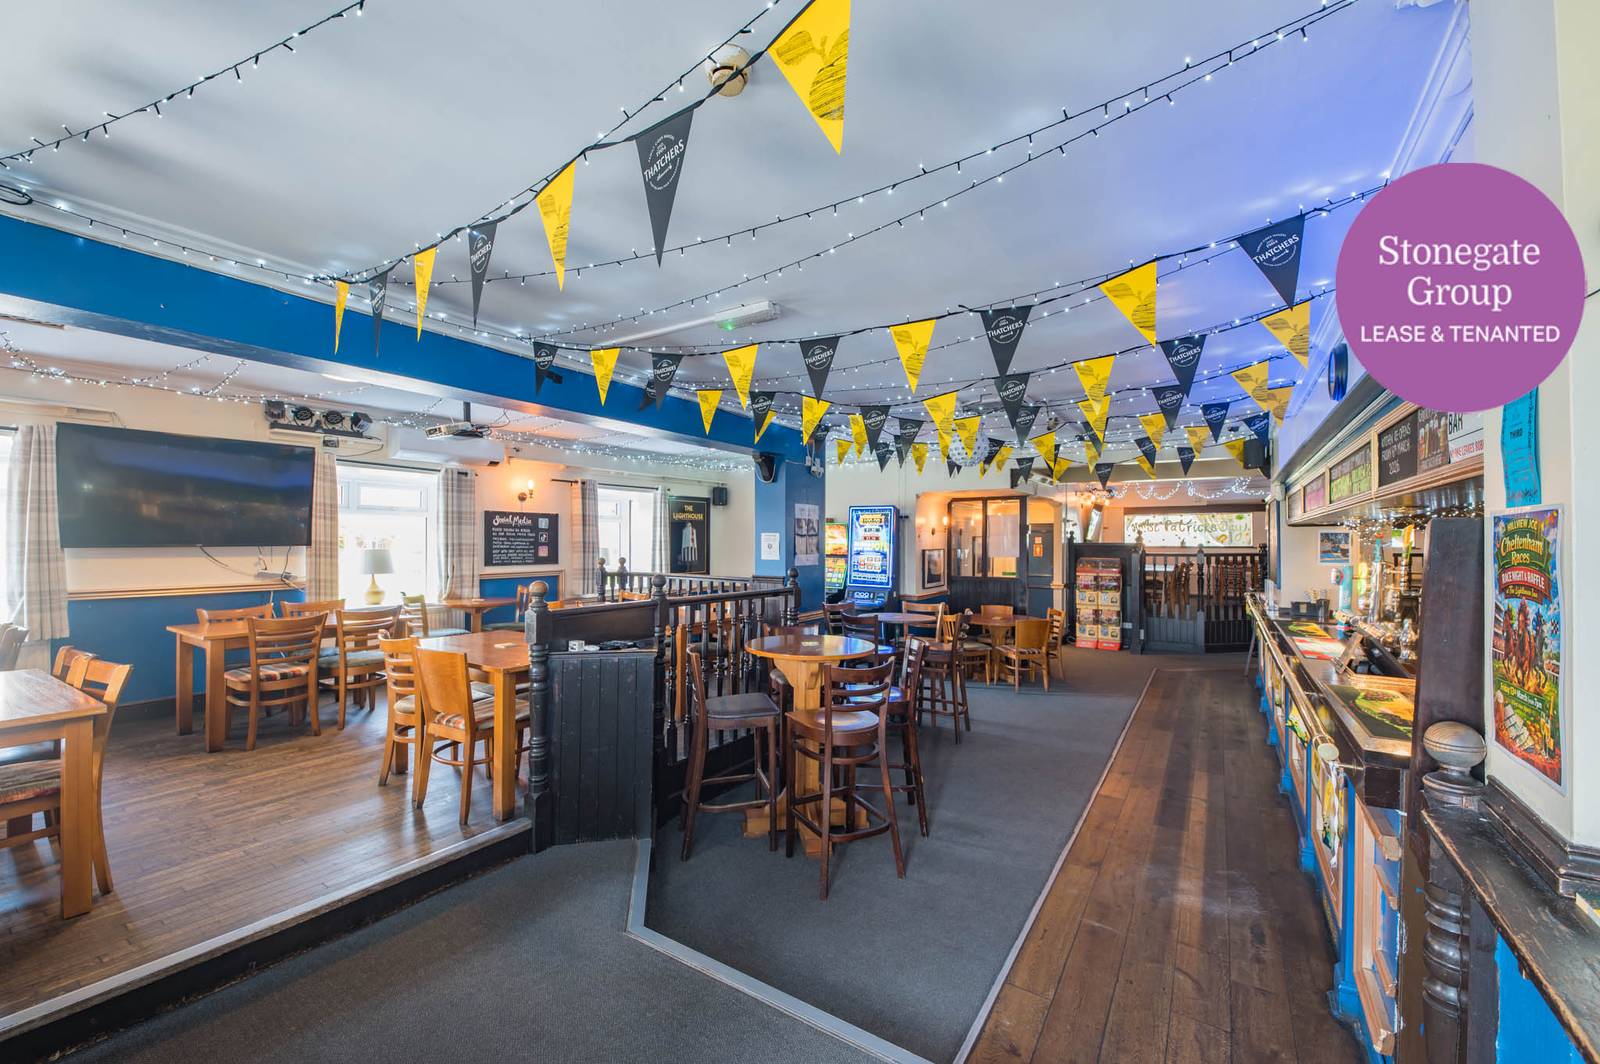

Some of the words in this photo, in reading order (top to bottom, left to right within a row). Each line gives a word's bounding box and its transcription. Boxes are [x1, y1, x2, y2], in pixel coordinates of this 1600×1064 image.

[643, 139, 685, 182] THATCHERS
[470, 240, 492, 264] THATCHERS
[1252, 234, 1300, 264] THATCHERS
[987, 319, 1024, 338] THATCHERS
[804, 348, 834, 364] THATCHERS
[1169, 346, 1201, 363] THATCHERS
[653, 364, 677, 375] THATCHERS
[1000, 383, 1026, 397] THATCHERS
[1158, 393, 1183, 405] THATCHERS
[864, 414, 886, 424] THATCHERS
[684, 504, 693, 512] THE
[492, 515, 512, 526] Social
[512, 515, 532, 527] Media
[672, 512, 704, 520] LIGHTHOUSE
[1501, 533, 1543, 557] Cheltenham
[1511, 551, 1530, 566] Races
[1502, 572, 1512, 585] RACE
[1512, 571, 1523, 582] NIGHT
[1528, 571, 1545, 589] RAFFLE
